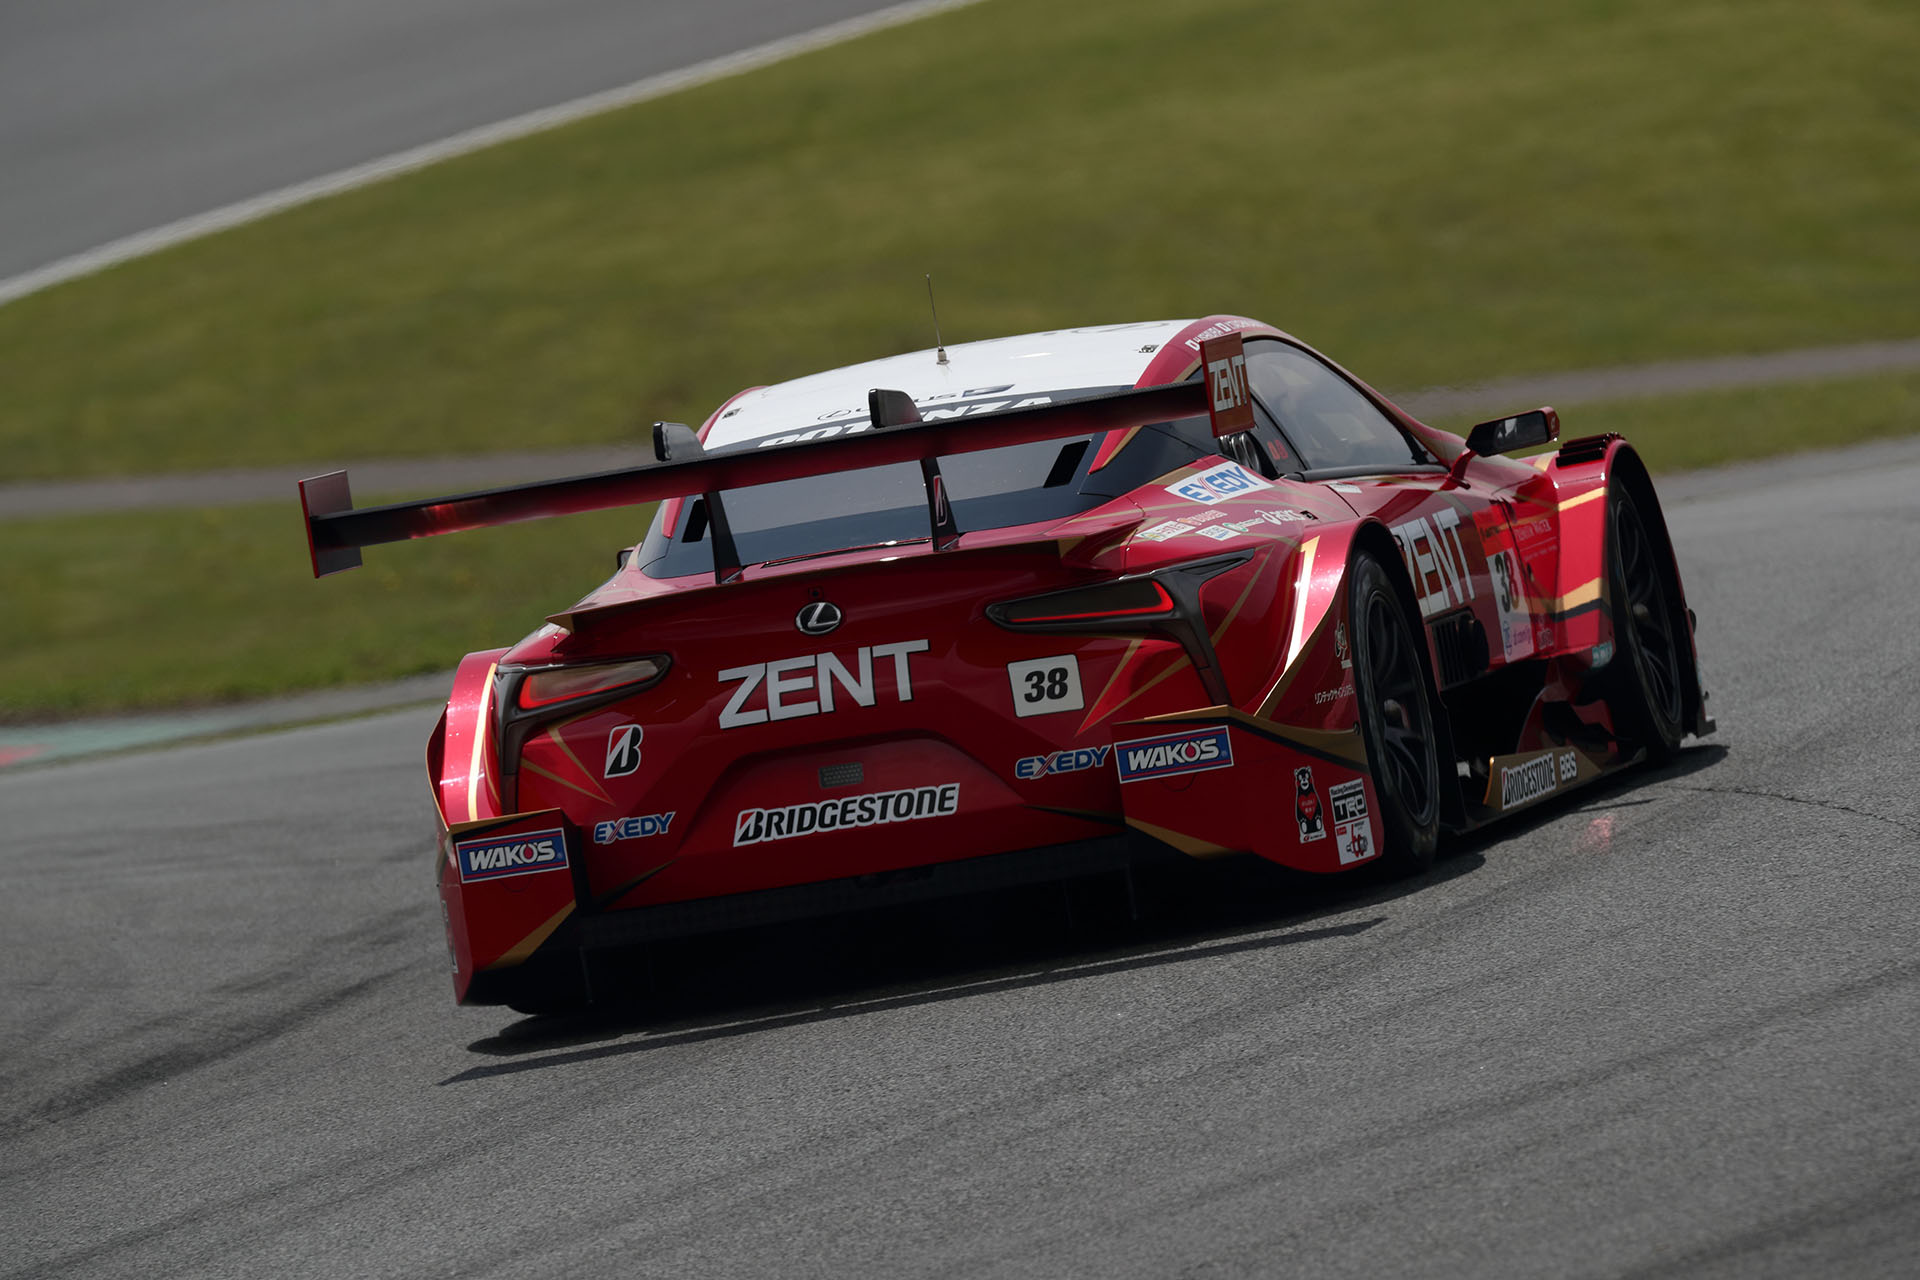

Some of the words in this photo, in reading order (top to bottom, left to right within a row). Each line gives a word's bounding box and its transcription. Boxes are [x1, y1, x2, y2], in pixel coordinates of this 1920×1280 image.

[1208, 354, 1248, 413] ZENT
[757, 396, 1053, 448] POTNZA
[1178, 466, 1259, 502] EXEDY
[1389, 507, 1476, 618] ZENT
[1494, 551, 1520, 614] 38
[718, 639, 930, 730] ZENT
[1024, 667, 1069, 703] 38
[1015, 744, 1112, 779] EXEDY
[1502, 752, 1557, 811] BRIDGESTONE
[1560, 751, 1577, 781] BBS
[594, 811, 677, 845] EXEDY
[733, 782, 961, 848] BRIDGESTONE
[1334, 794, 1365, 819] TRD
